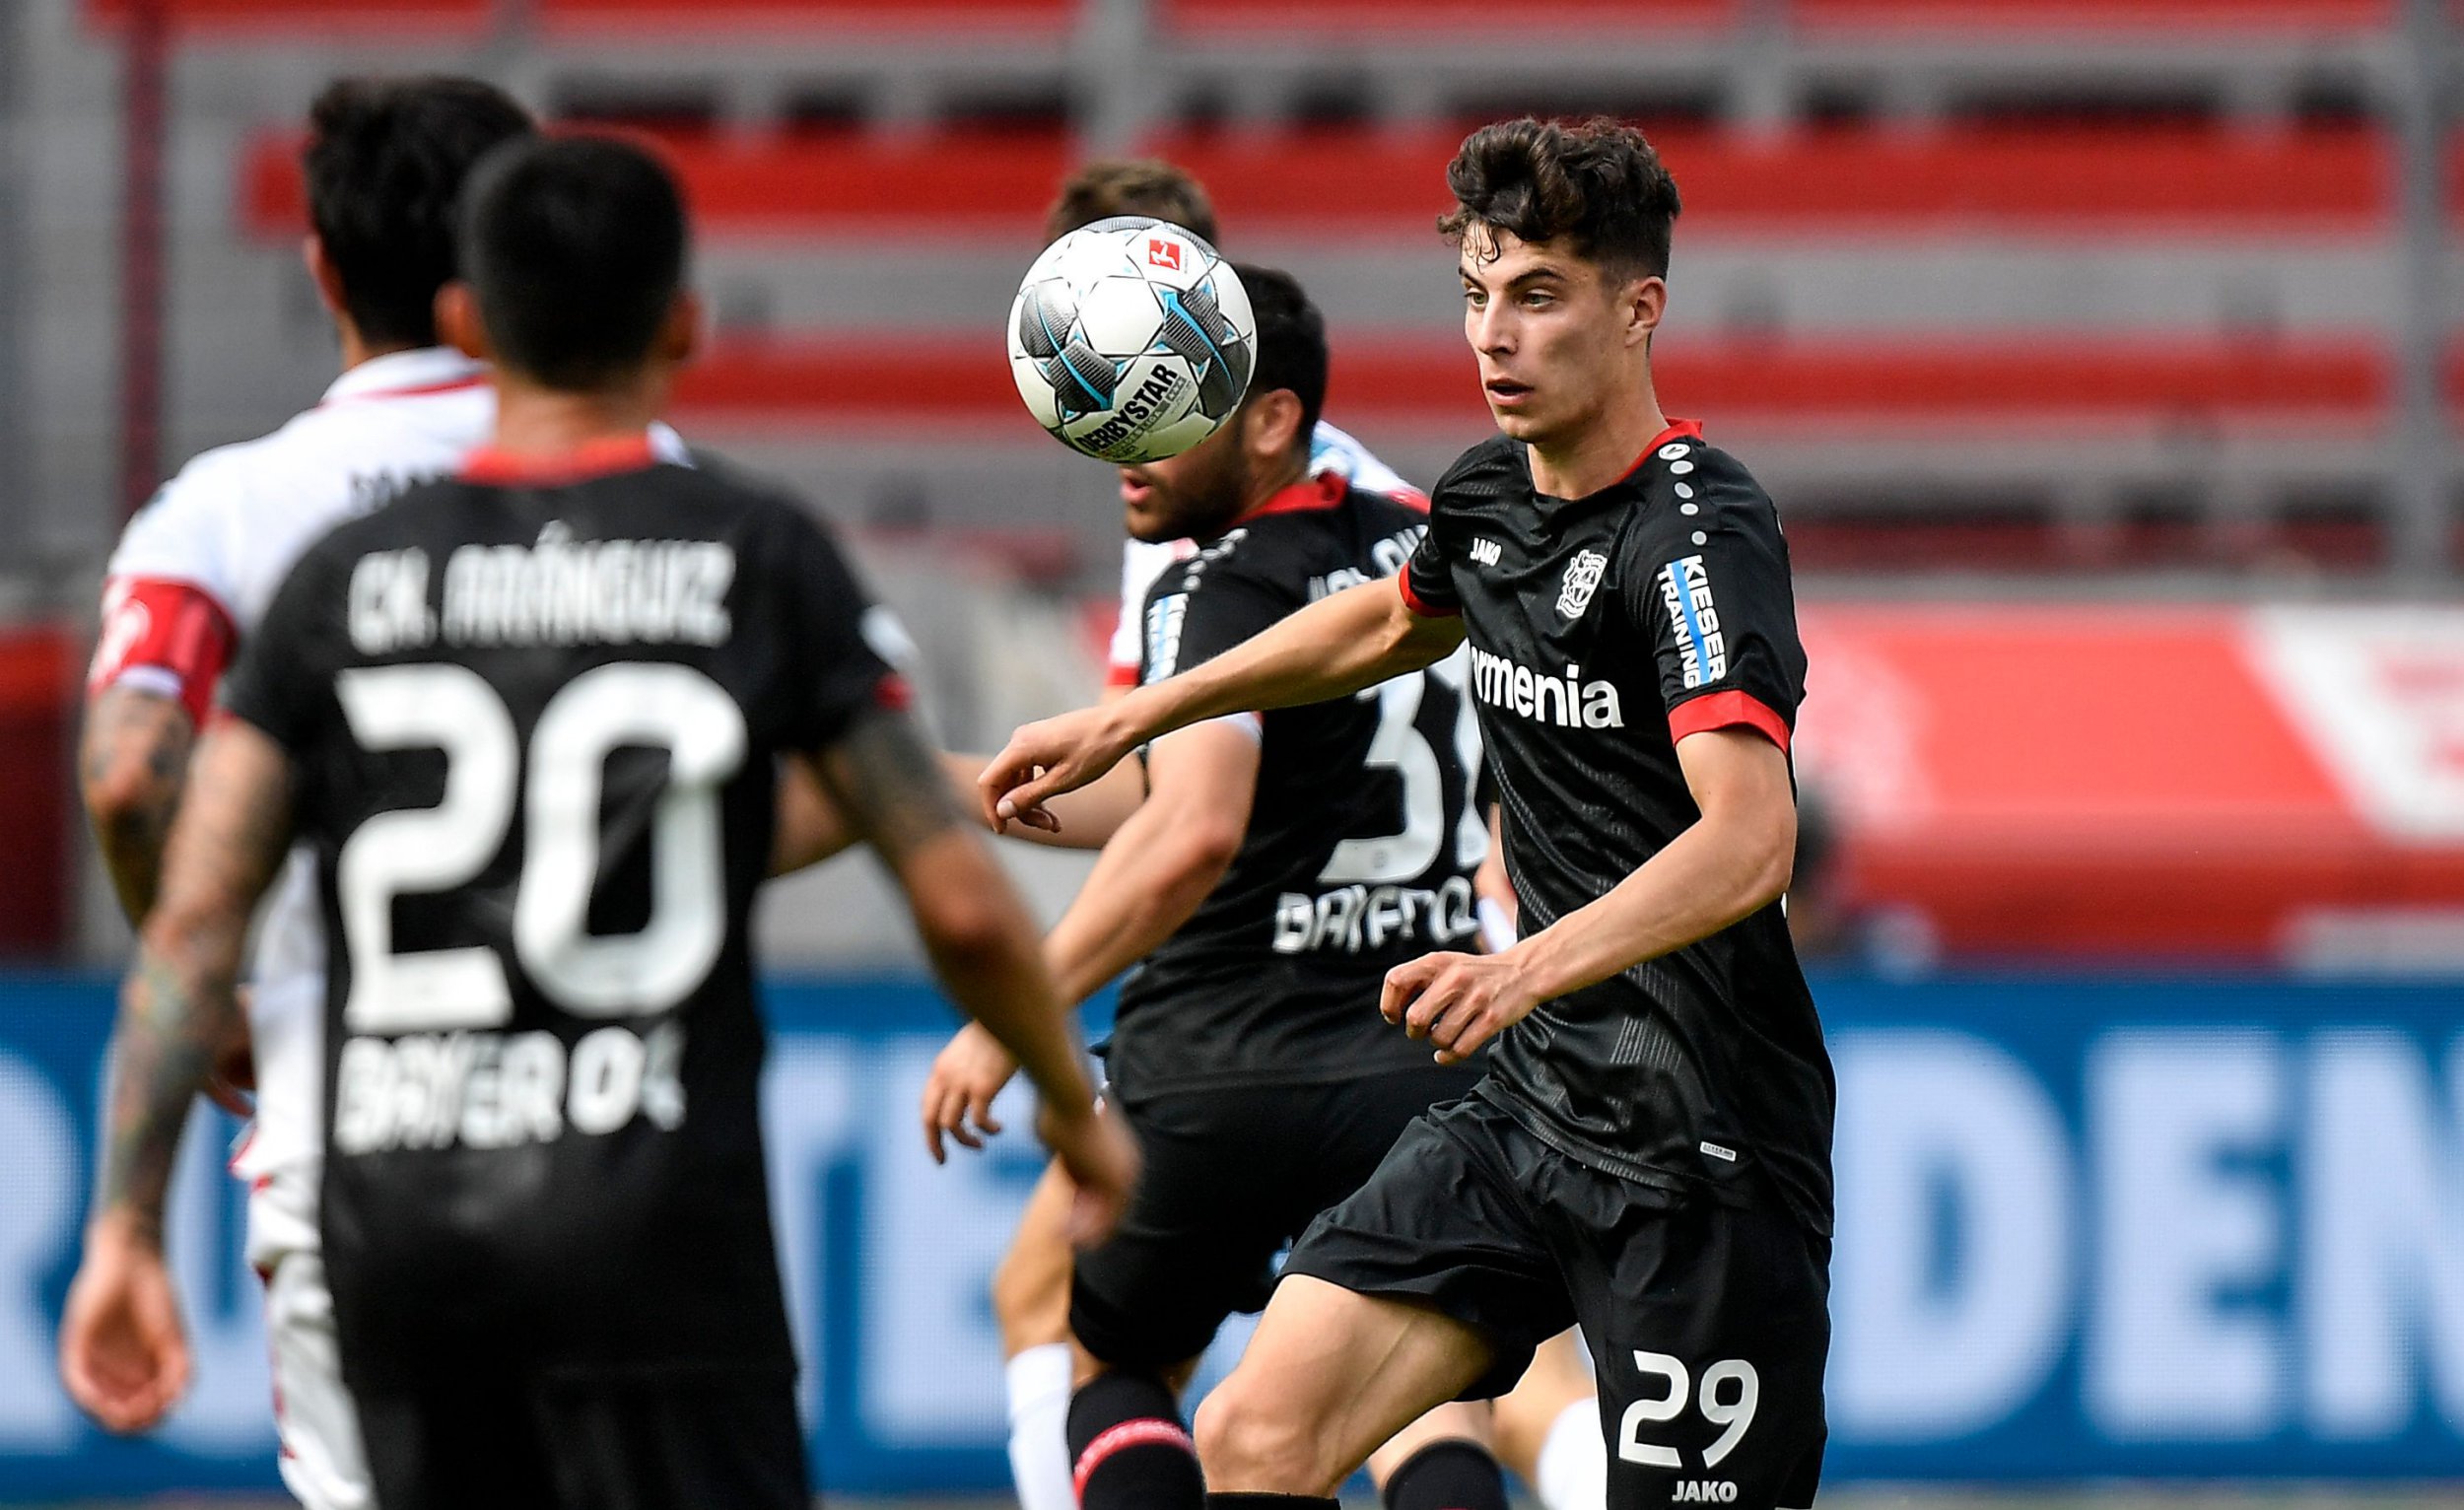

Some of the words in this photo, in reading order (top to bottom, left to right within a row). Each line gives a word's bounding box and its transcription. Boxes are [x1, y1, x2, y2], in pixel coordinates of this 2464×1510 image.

[1075, 364, 1178, 451] DERBYSTAR
[1471, 537, 1502, 567] JAKO
[1657, 563, 1703, 689] TRAINING
[1680, 554, 1727, 682] KIESER
[335, 661, 749, 1033] 20
[336, 1029, 568, 1154] BAYER
[1618, 1350, 1758, 1469] 29
[1672, 1480, 1738, 1502] JAKO
